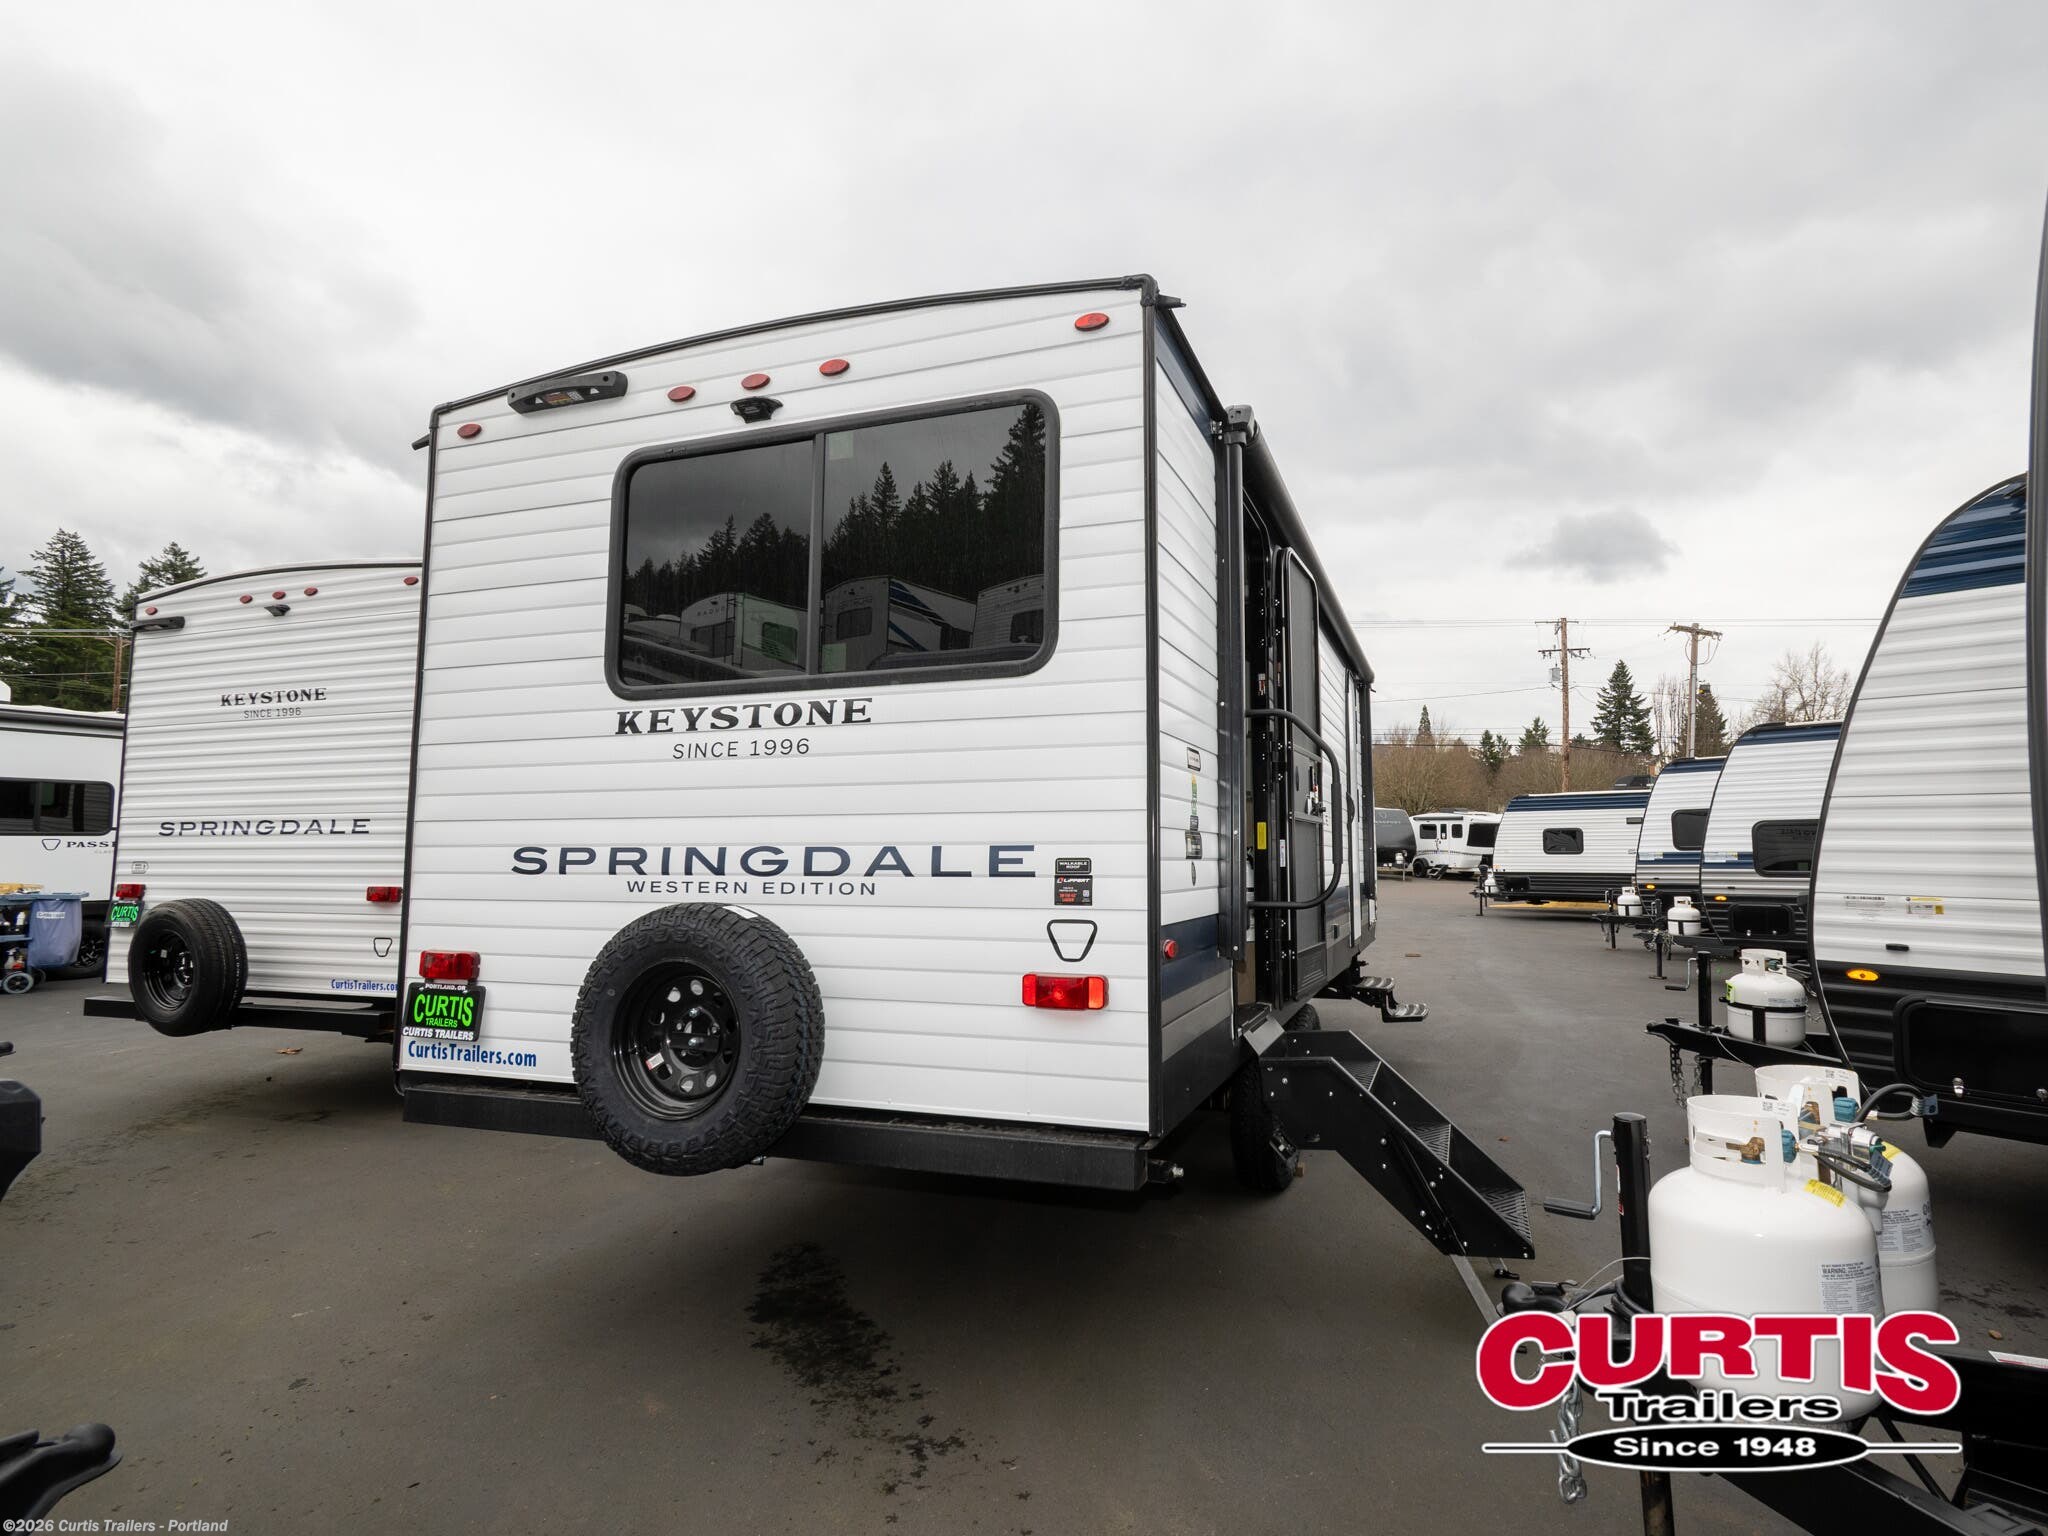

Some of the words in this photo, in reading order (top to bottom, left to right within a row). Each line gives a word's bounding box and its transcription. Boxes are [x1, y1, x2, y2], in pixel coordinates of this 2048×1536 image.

[220, 687, 327, 707] KEYSTONE
[243, 708, 272, 719] SINCE
[276, 706, 302, 717] 1996
[614, 697, 873, 735] KEYSTONE
[672, 741, 739, 760] SINCE
[750, 737, 810, 757] 1996
[158, 818, 371, 837] SPRINGDALE
[511, 845, 1037, 878] SPRINGDALE
[627, 880, 748, 894] WESTERN
[762, 881, 876, 896] EDITION
[111, 905, 139, 922] CURTIS
[413, 993, 474, 1027] CURTIS
[425, 1017, 458, 1028] TRAILERS
[402, 1026, 433, 1038] CURTIS
[434, 1028, 474, 1041] TRAILERS
[408, 1040, 537, 1067] CurtisTrailers.com
